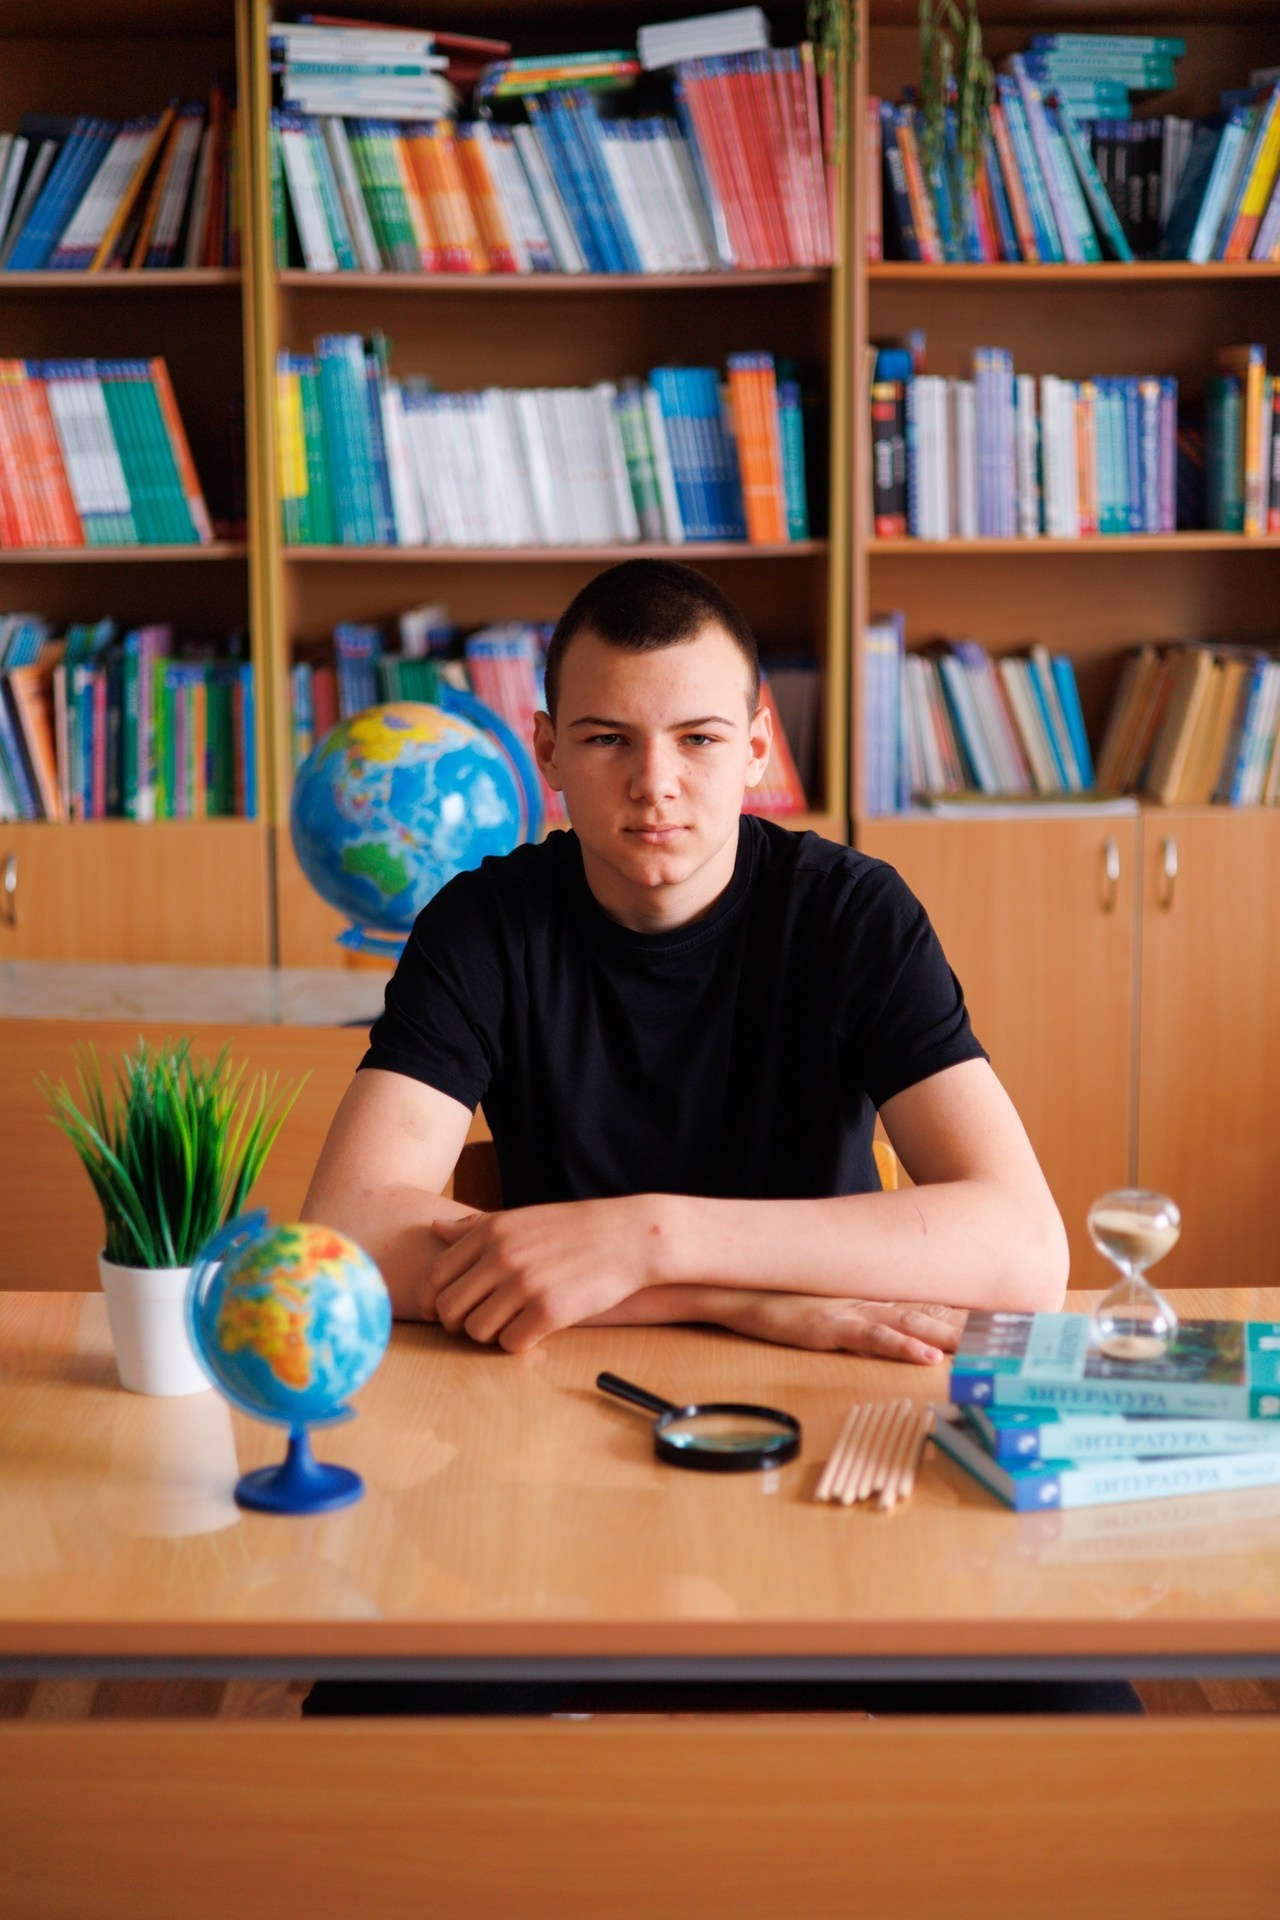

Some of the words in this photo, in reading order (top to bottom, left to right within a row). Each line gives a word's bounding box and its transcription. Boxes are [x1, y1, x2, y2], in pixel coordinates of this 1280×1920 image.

[1026, 1386, 1167, 1409] ЛИТЕРАТУРА
[1072, 1431, 1210, 1449] ЛИТЕРАТУРА
[1088, 1467, 1220, 1495] ЛИТЕРАТУРА
